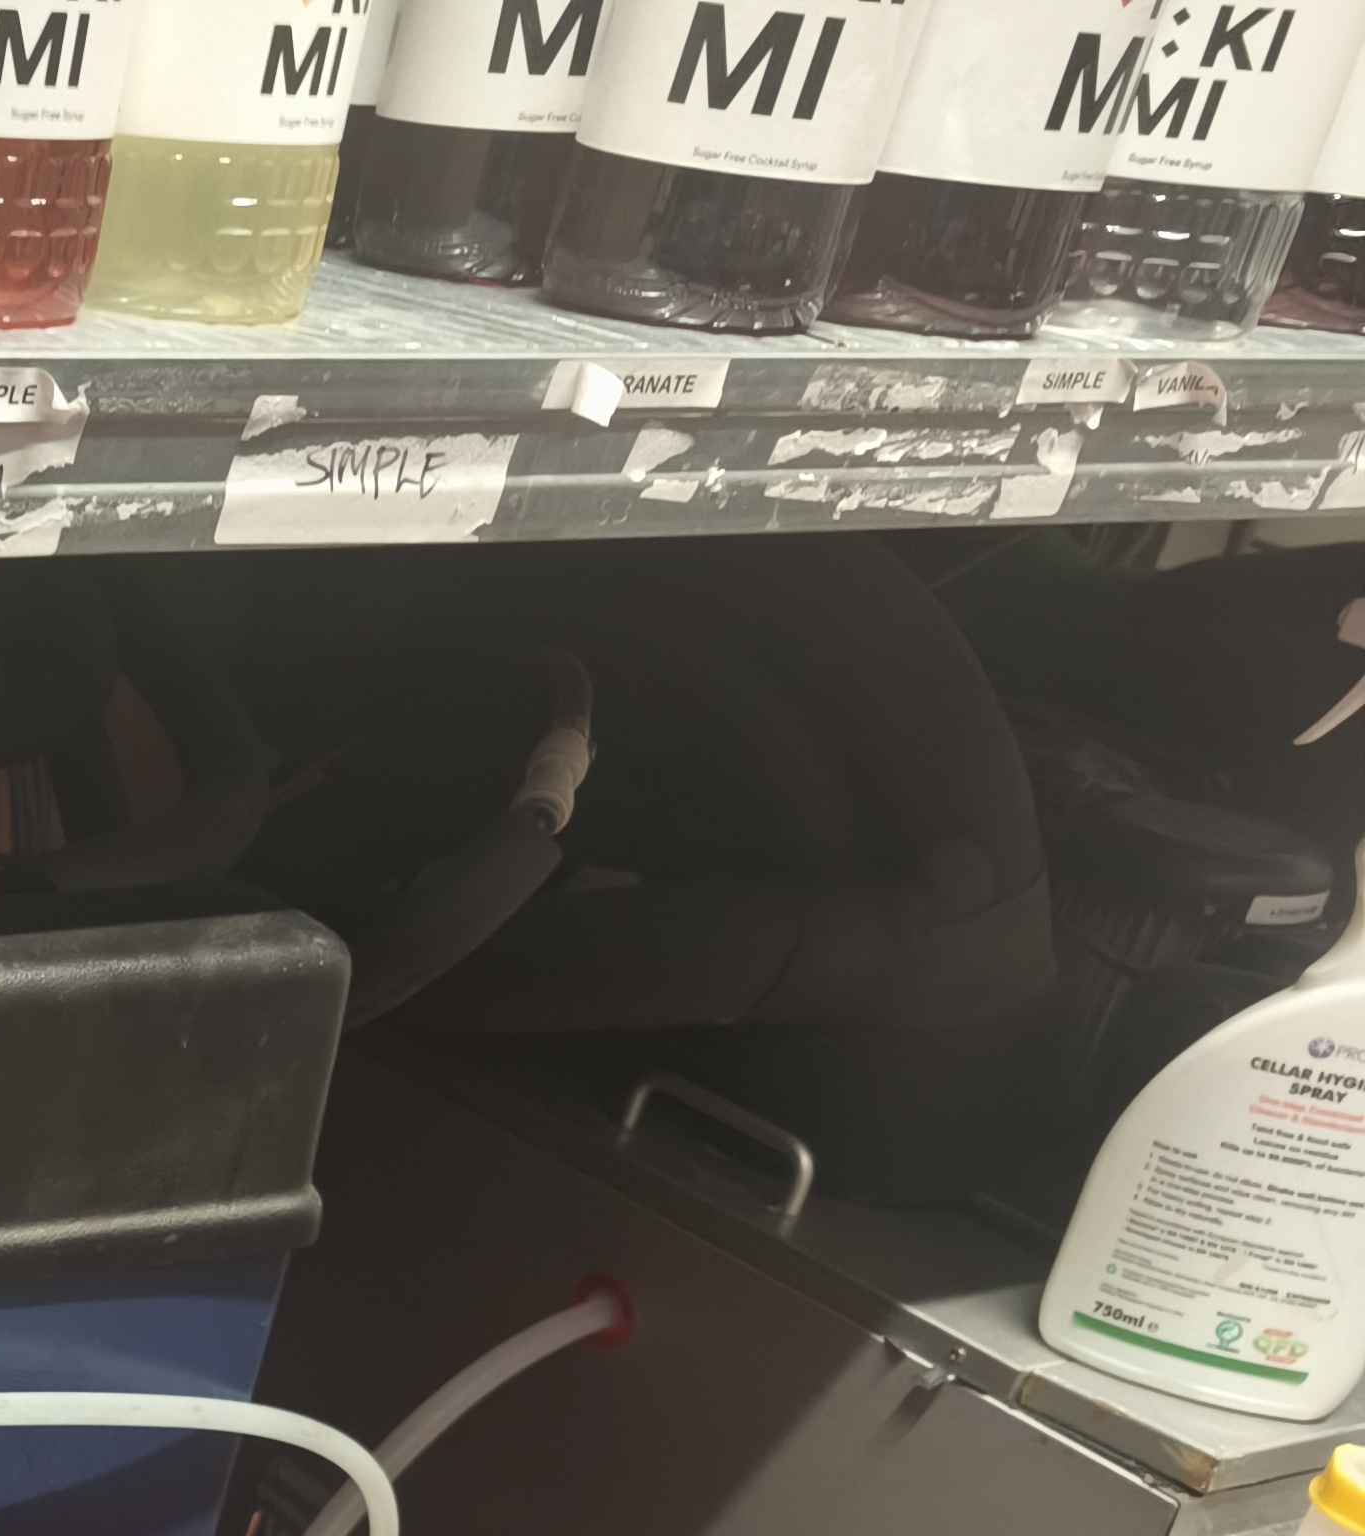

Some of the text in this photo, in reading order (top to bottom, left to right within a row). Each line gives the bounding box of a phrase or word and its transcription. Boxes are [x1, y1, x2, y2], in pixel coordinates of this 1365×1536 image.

[488, 0, 605, 77] M
[261, 25, 348, 96] MI
[667, 1, 846, 120] MI
[624, 373, 698, 394] RANATE
[1042, 371, 1106, 390] SIMPLE
[295, 446, 448, 500] SIMPLE
[1250, 1057, 1365, 1091] CELLAR HYGI
[1288, 1082, 1348, 1104] SPRAY
[1093, 1301, 1145, 1329] 750ml
